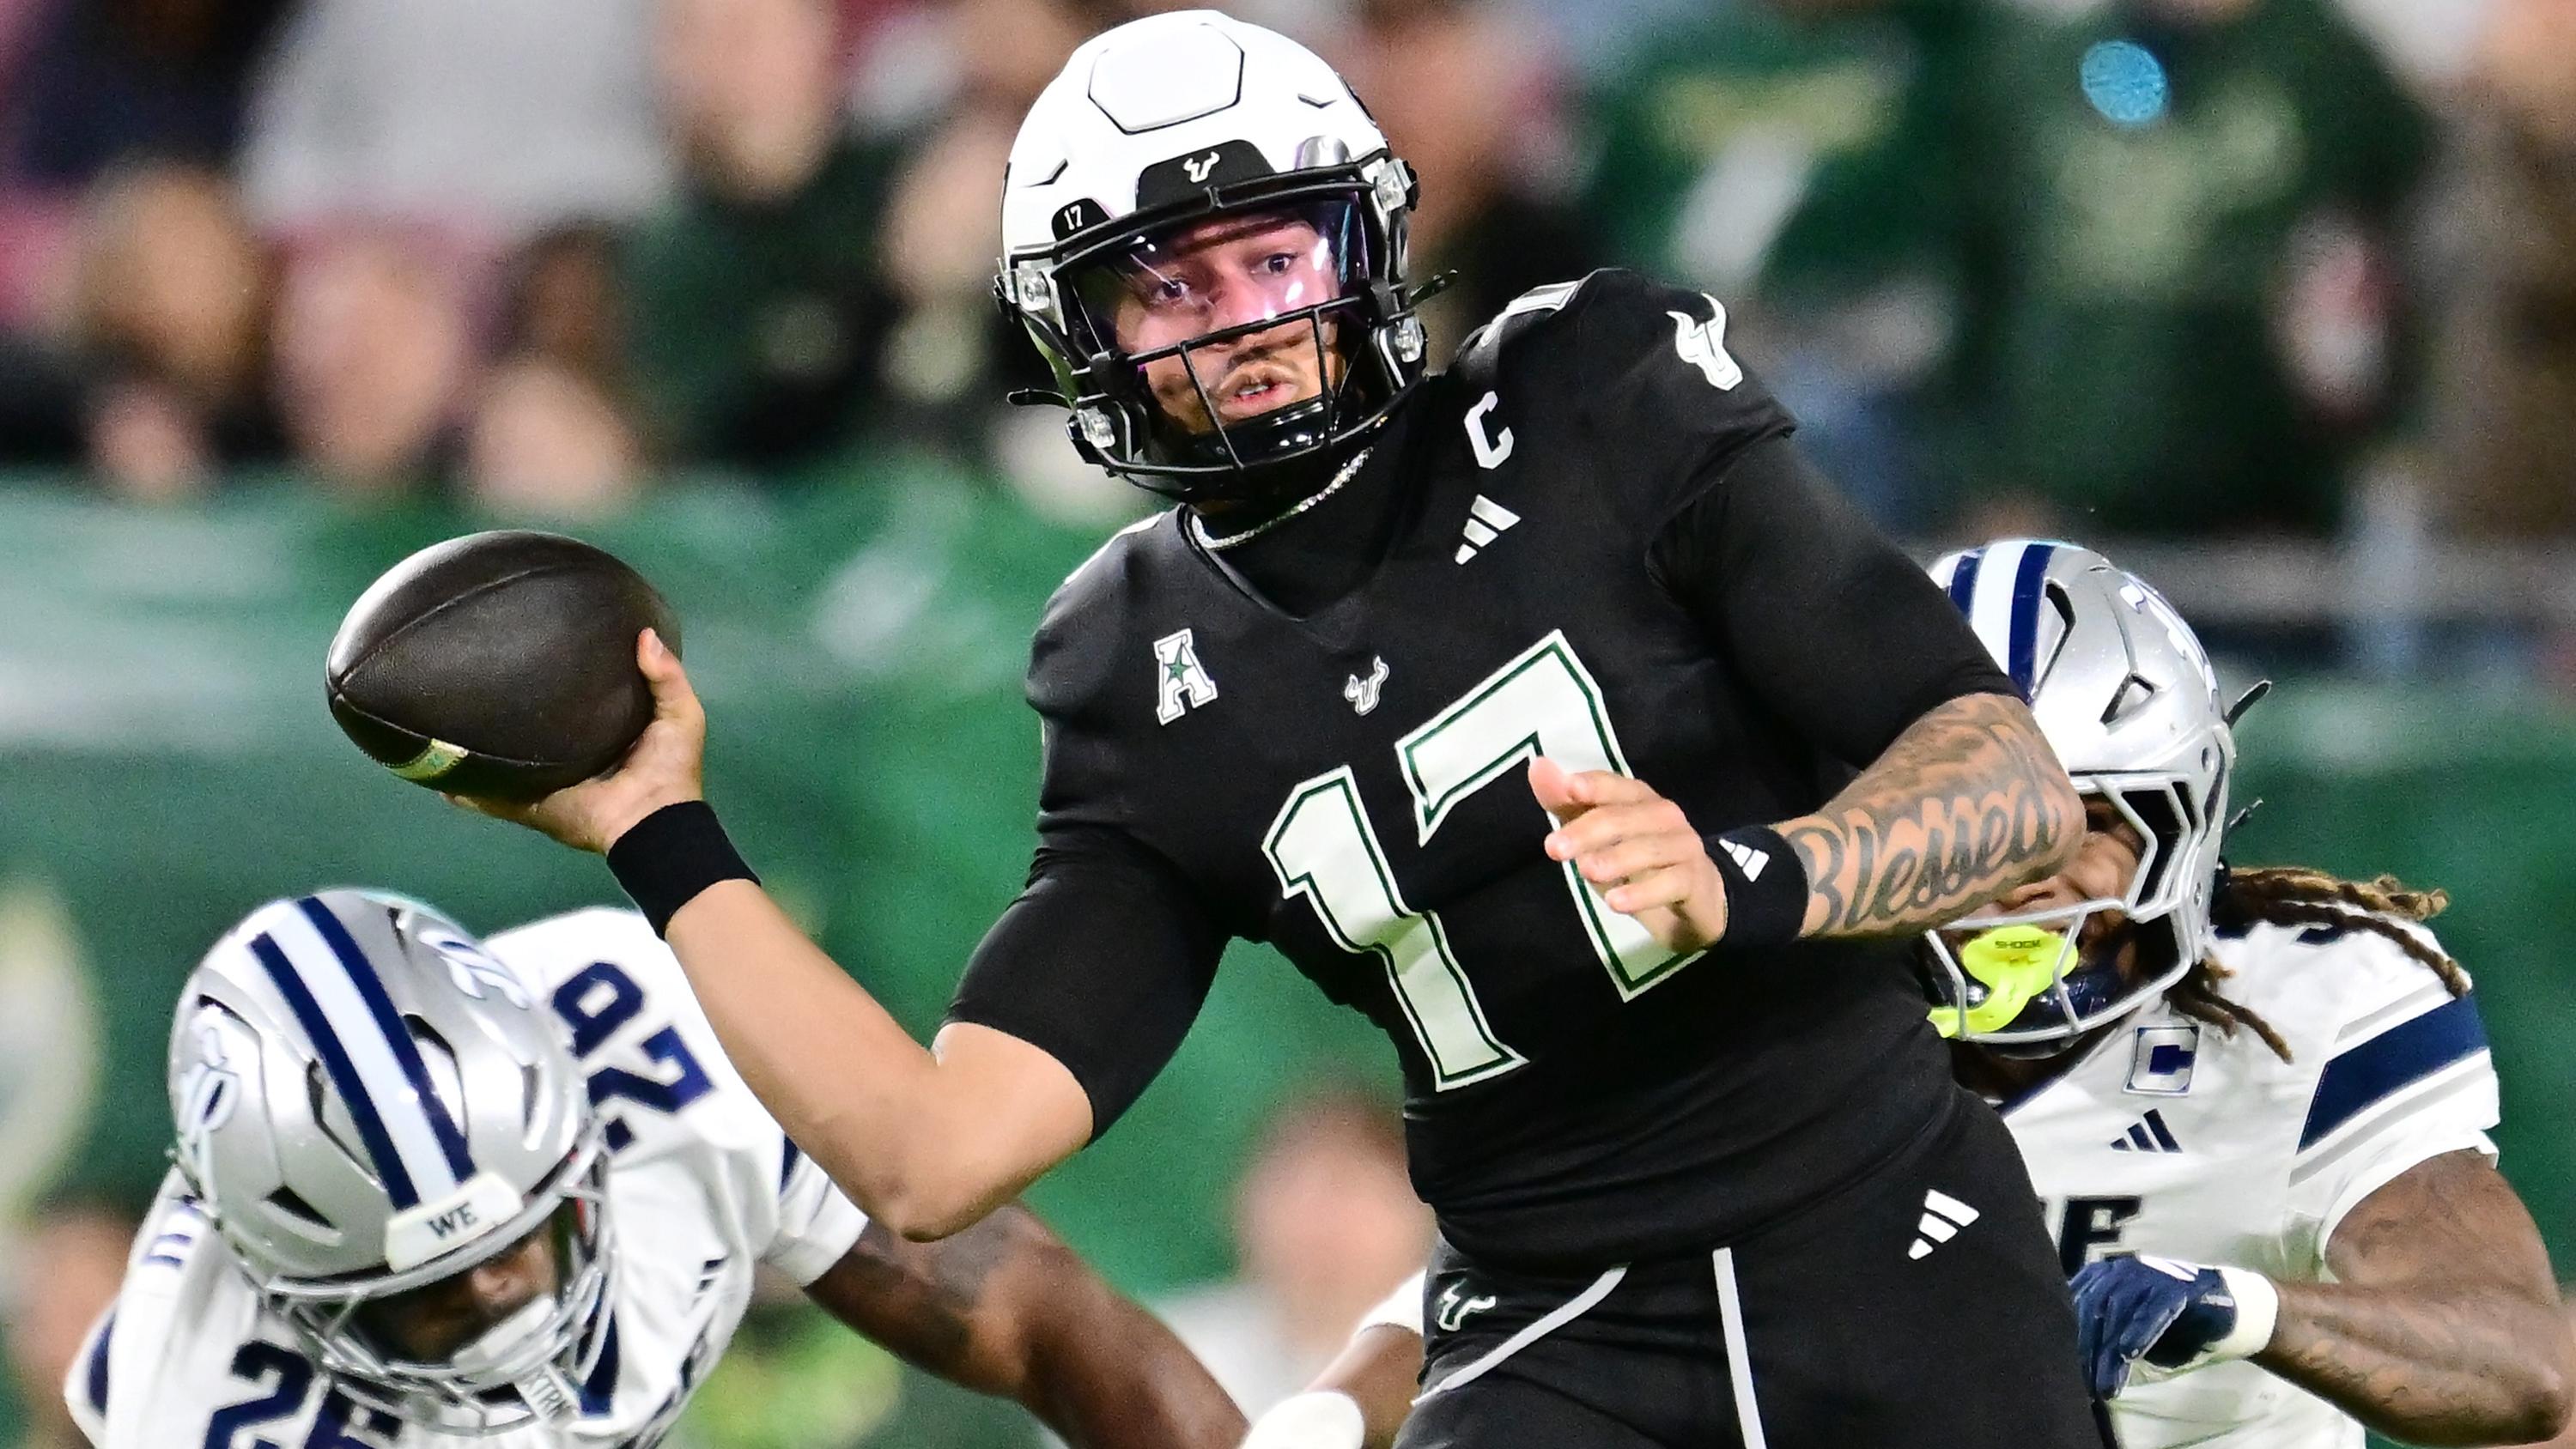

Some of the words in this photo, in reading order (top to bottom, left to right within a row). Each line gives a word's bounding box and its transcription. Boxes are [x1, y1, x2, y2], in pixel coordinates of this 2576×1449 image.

[1064, 204, 1083, 231] 17
[1464, 391, 1514, 470] C
[1153, 628, 1218, 725] A
[1261, 628, 1708, 1092] 17
[1995, 939, 2041, 949] SHOCK
[426, 1201, 478, 1238] WE
